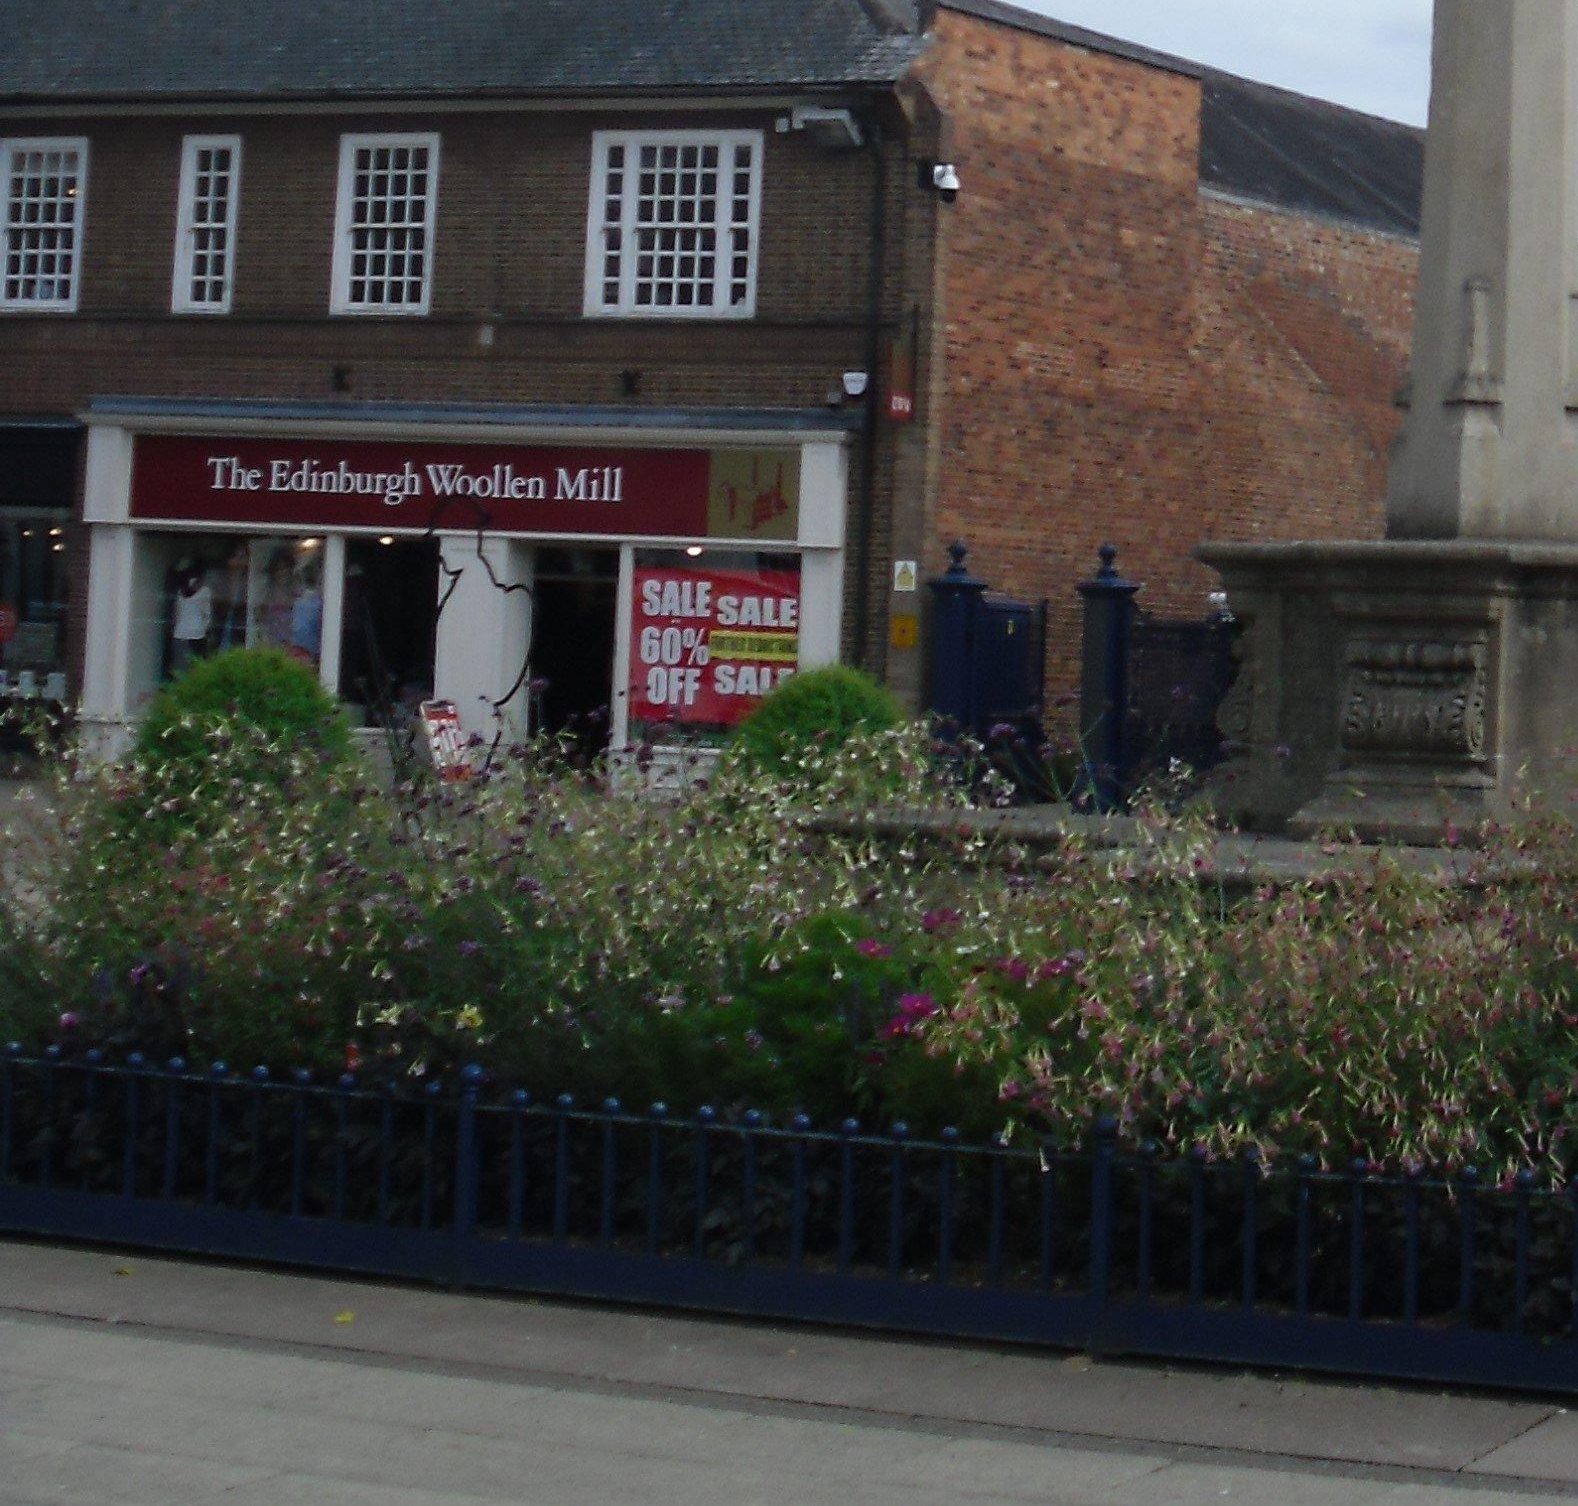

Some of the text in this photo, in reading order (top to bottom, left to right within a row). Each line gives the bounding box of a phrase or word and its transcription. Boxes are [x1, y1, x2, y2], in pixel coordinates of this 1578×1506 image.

[207, 457, 622, 506] The Edinburgh Woollen Mill
[641, 579, 712, 617] SALE
[716, 595, 799, 627] SALE
[640, 626, 711, 666] 60%
[646, 666, 703, 706] OFF
